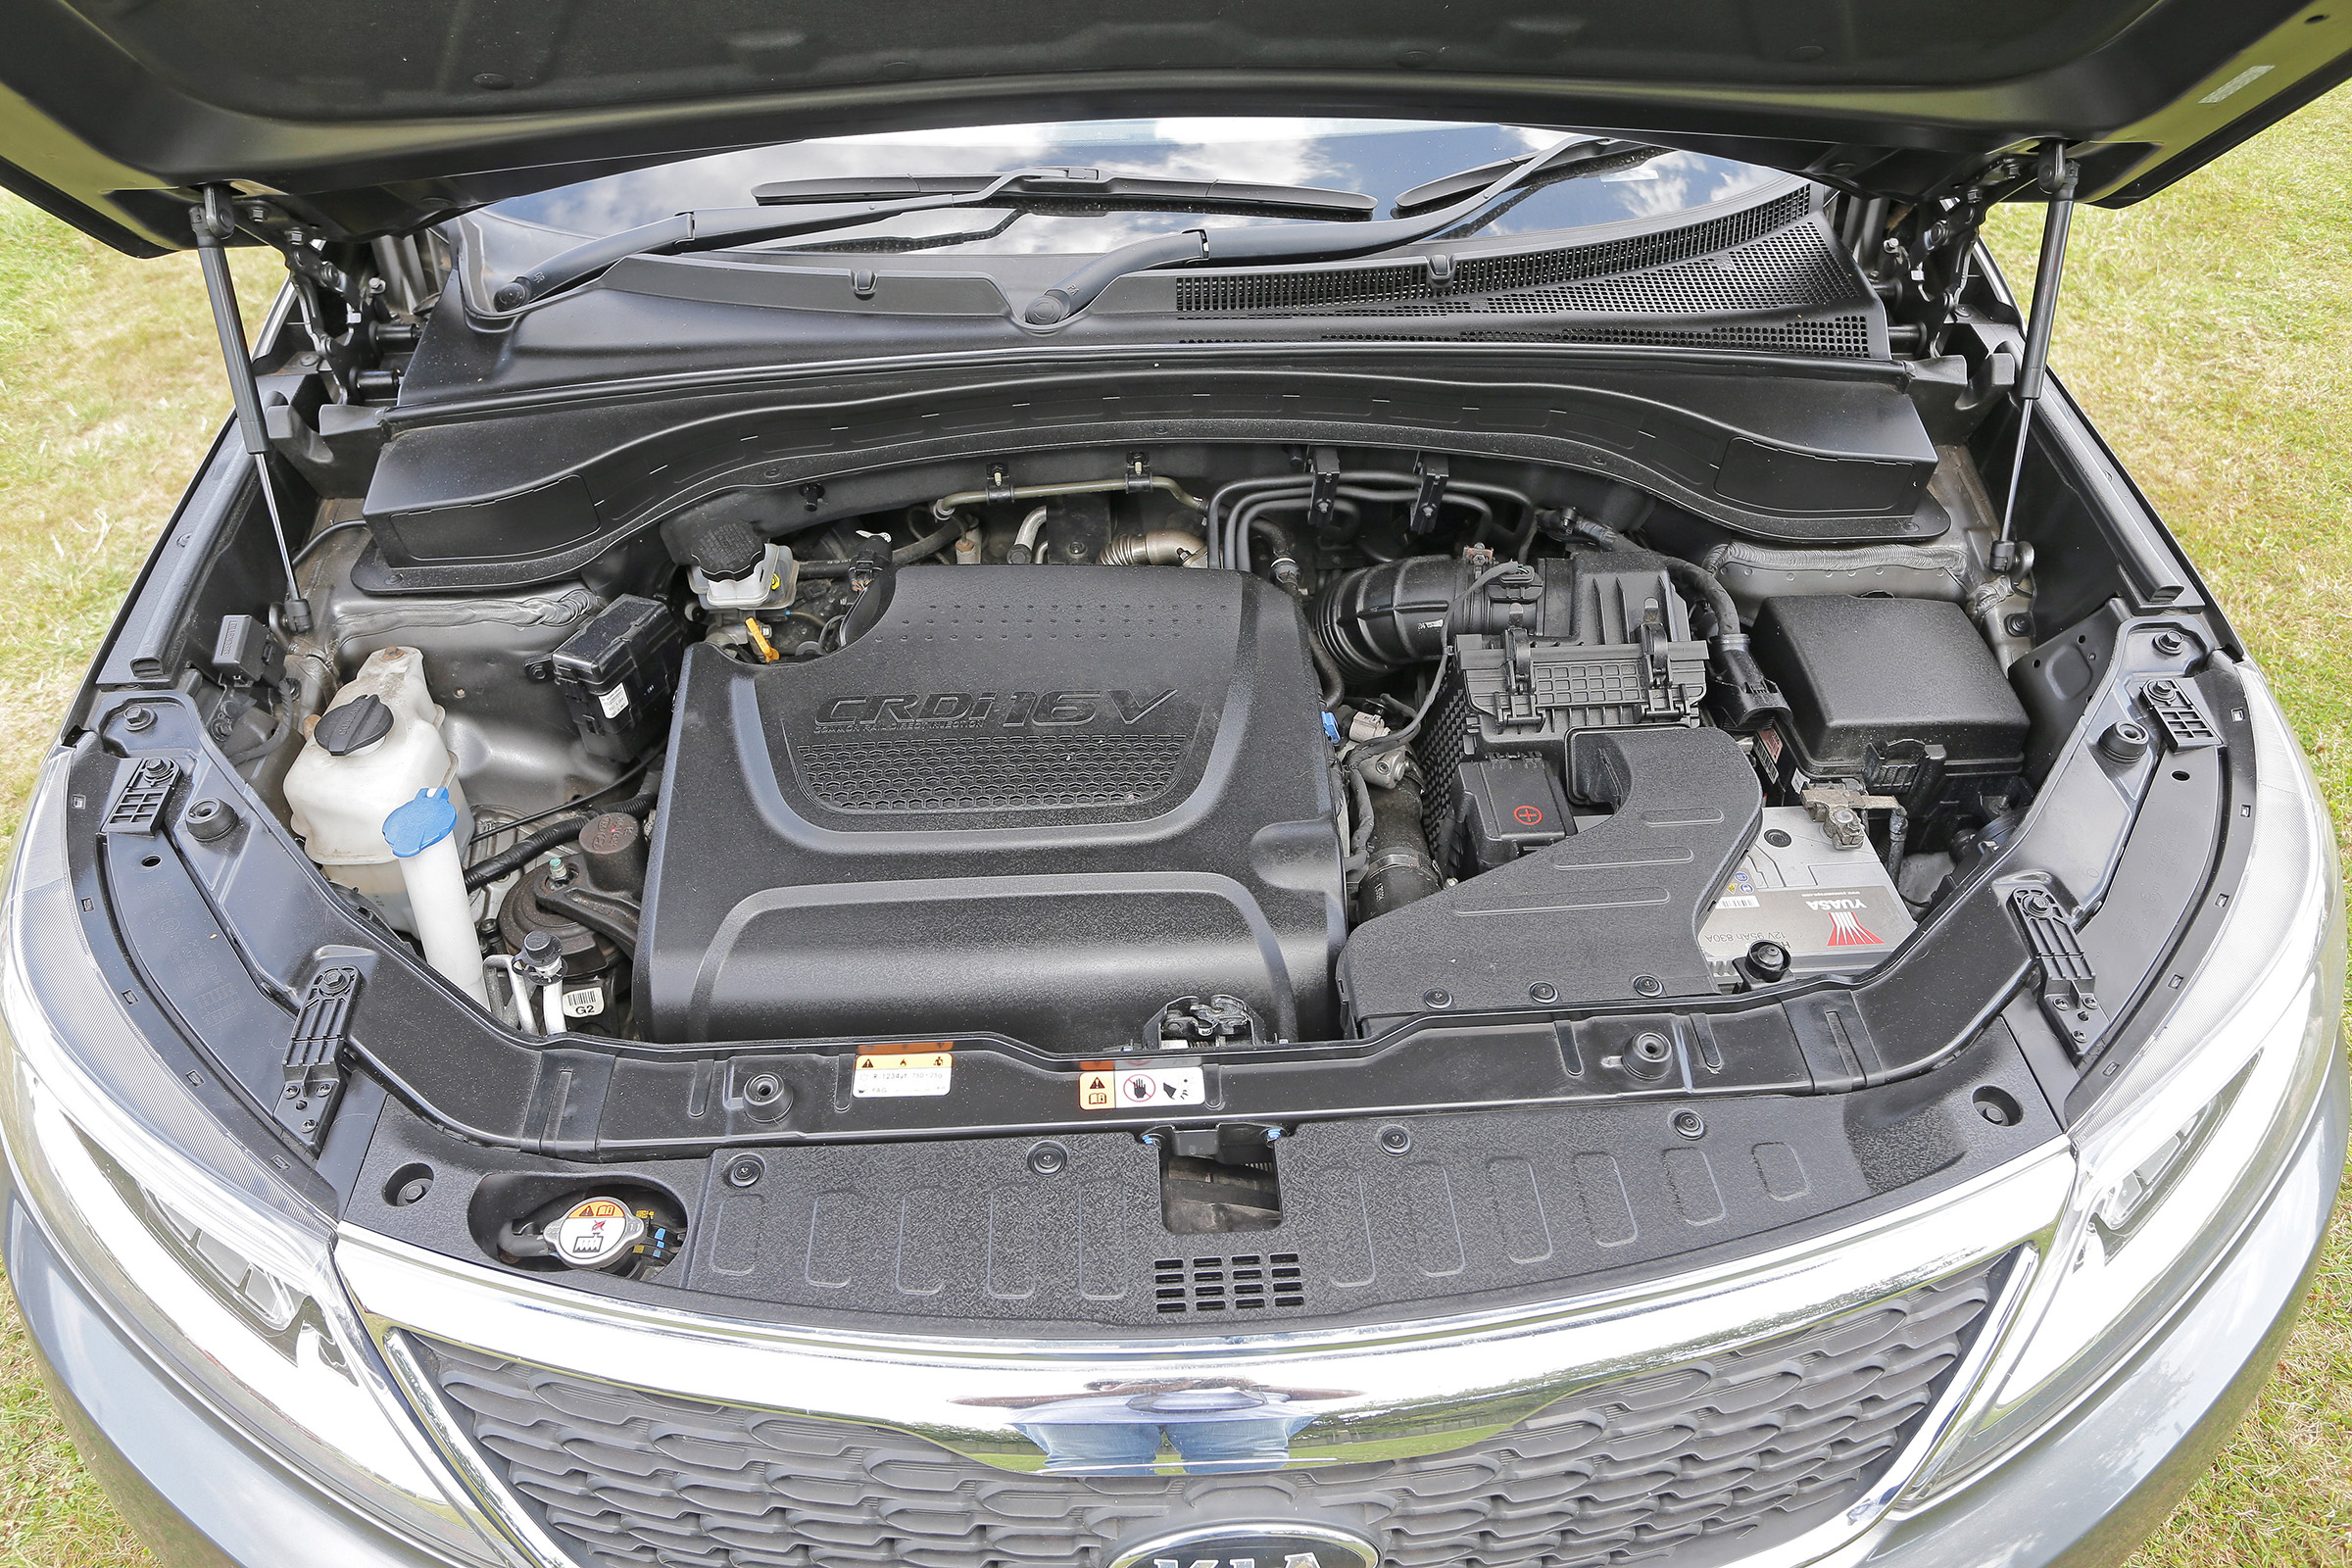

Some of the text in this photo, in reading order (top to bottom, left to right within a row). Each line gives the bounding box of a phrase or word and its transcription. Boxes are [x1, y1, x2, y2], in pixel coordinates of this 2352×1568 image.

[1804, 899, 1868, 910] YUASA
[1704, 931, 1786, 943] 12V 95Ah 830A
[575, 1004, 595, 1015] G2
